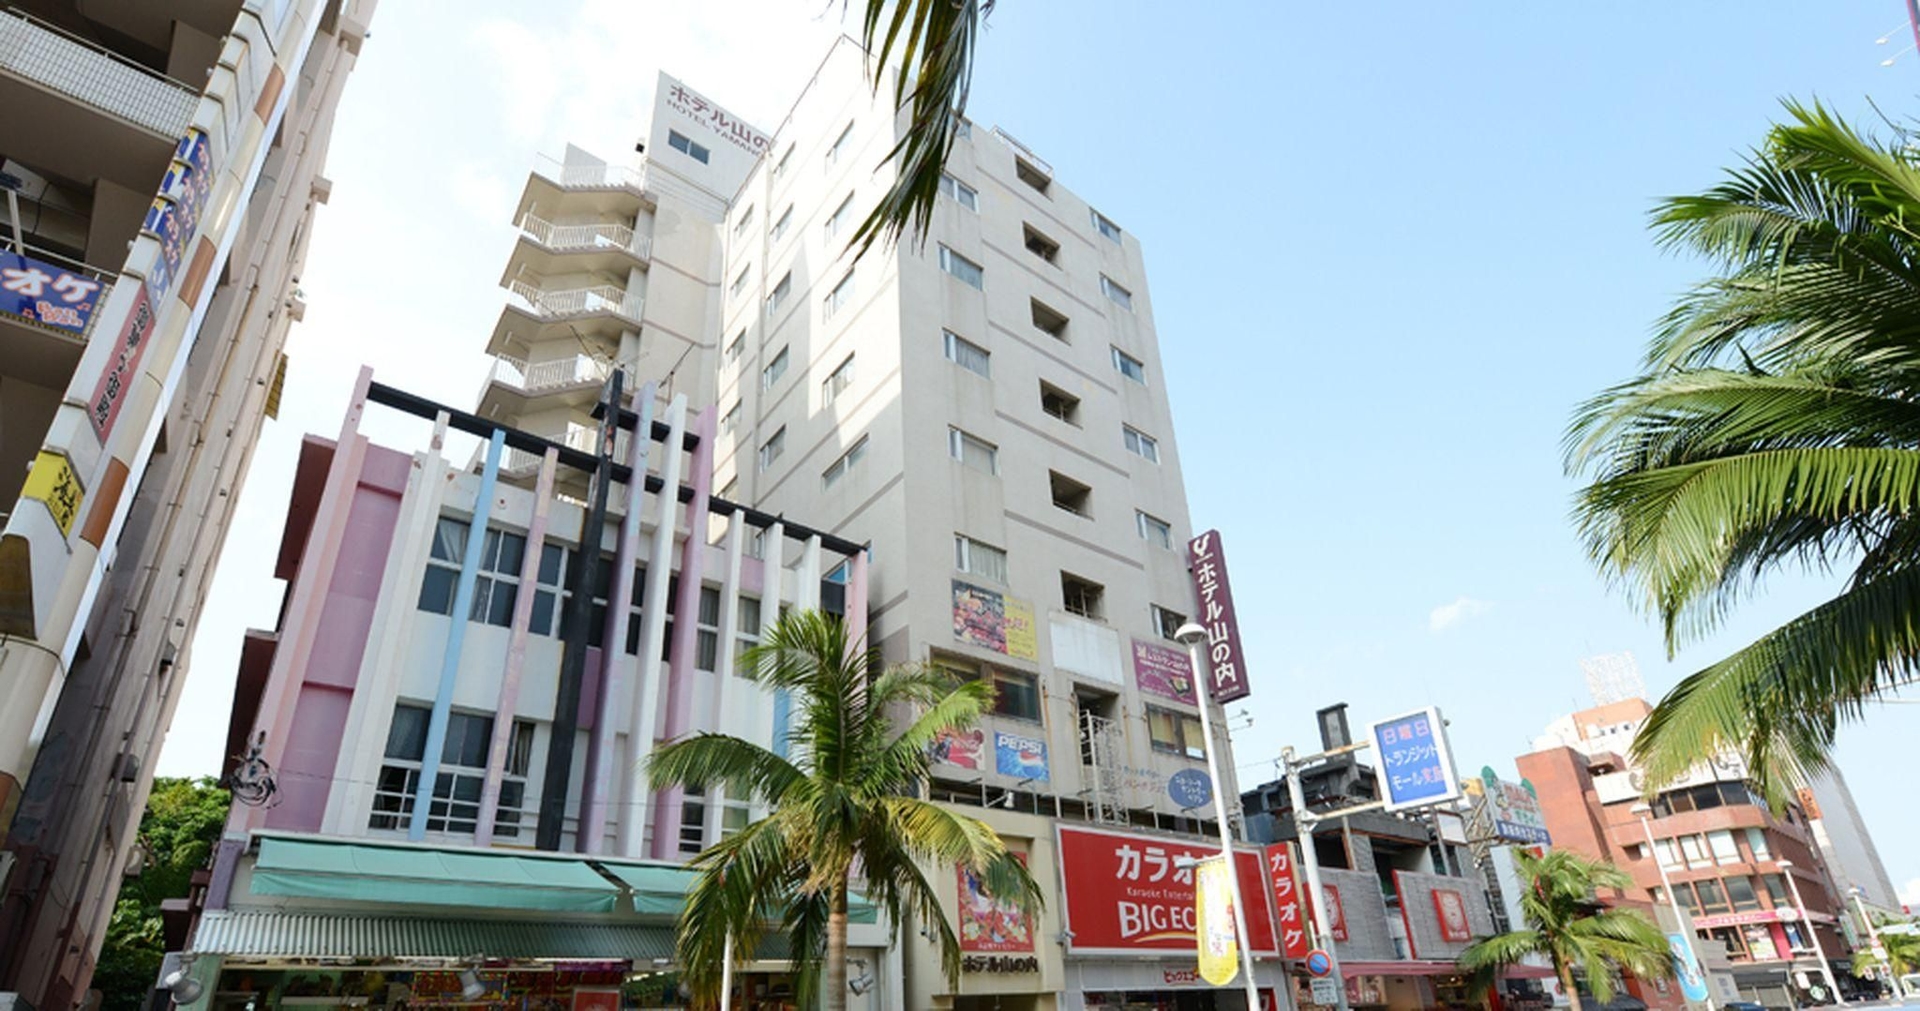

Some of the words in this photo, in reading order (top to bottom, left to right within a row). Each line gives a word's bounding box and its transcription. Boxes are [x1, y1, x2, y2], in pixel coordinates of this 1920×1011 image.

[670, 84, 770, 151] ホテル山の
[0, 267, 99, 303] オケ
[1197, 562, 1237, 688] ホテル山の内
[998, 735, 1043, 754] PEPSI
[1383, 743, 1437, 768] トランジット
[1270, 853, 1303, 949] カラオケ
[1117, 900, 1168, 939] BIG
[963, 955, 1039, 973] ホテル山の内
[1163, 968, 1200, 984] ビッグエコ
